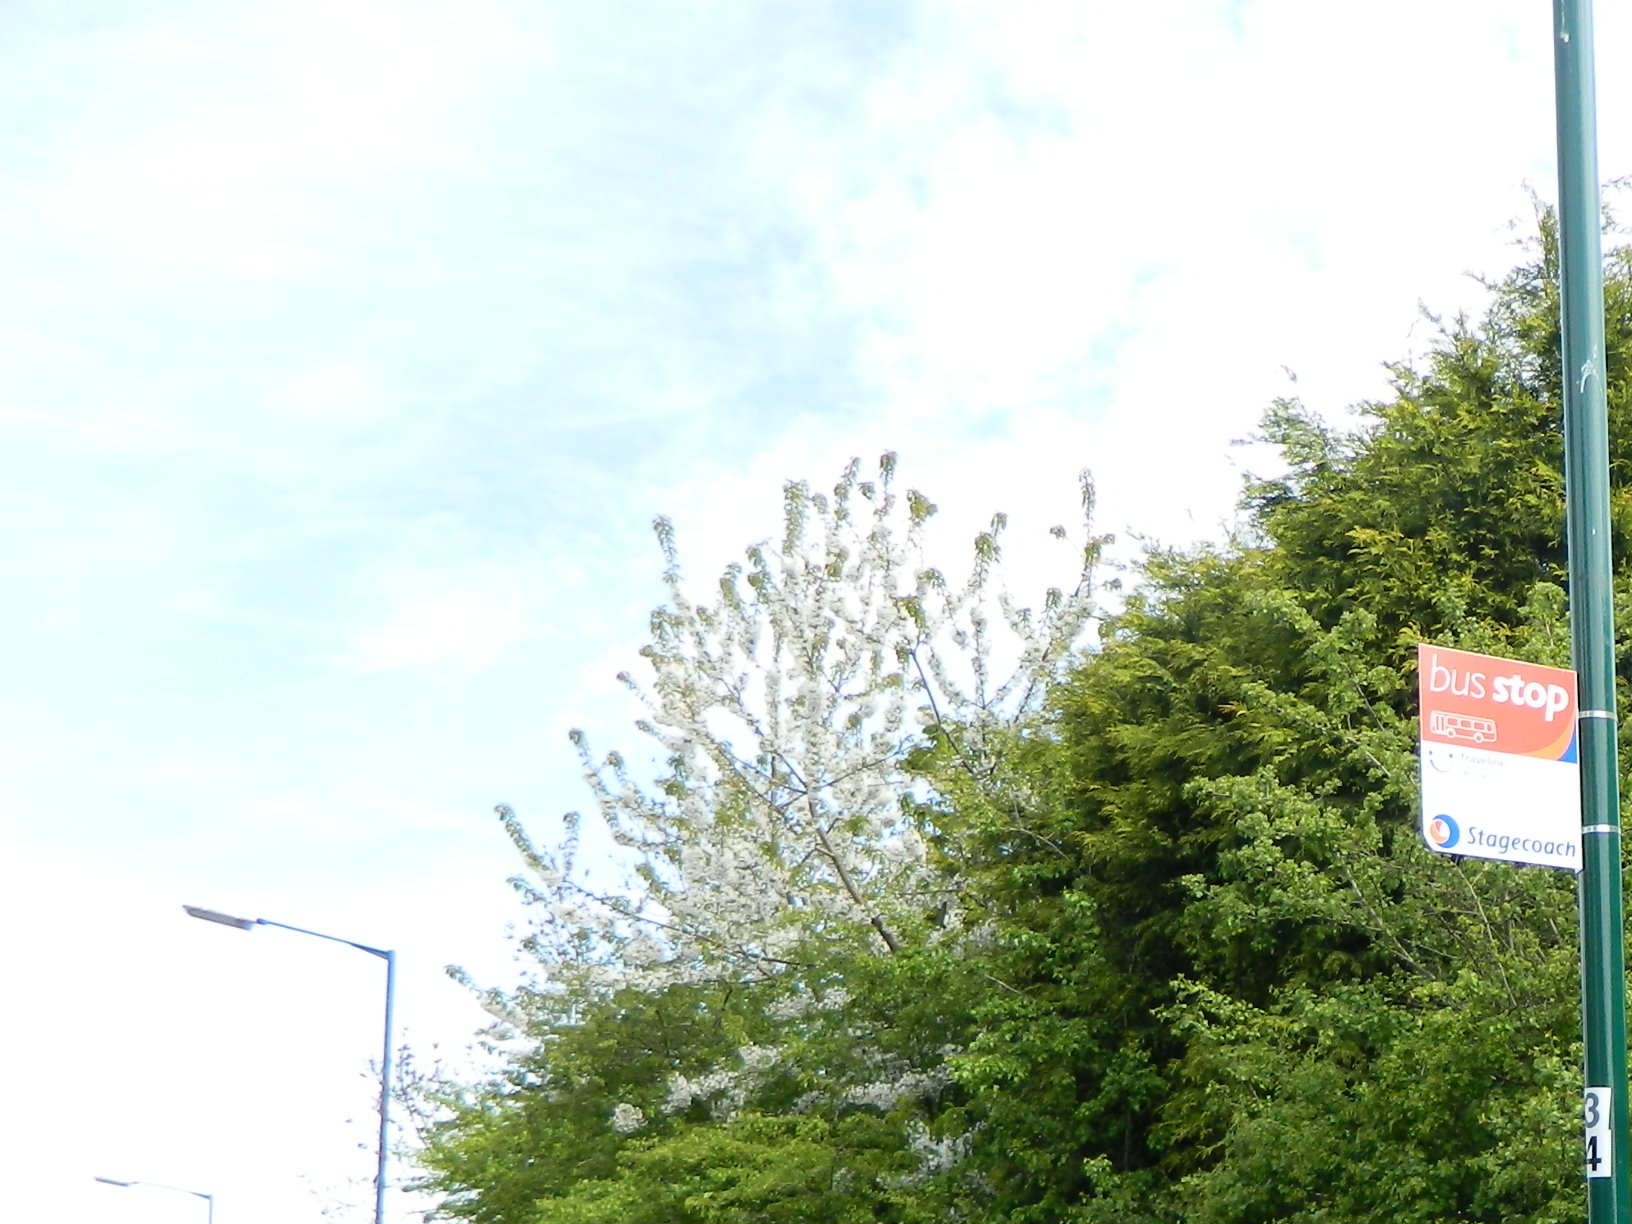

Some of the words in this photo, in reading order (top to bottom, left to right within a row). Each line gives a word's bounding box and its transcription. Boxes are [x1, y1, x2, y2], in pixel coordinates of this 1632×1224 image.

[1429, 653, 1487, 700] bus
[1492, 673, 1570, 722] stop
[1467, 826, 1577, 858] Stagecoach
[1584, 1092, 1600, 1129] 3
[1586, 1135, 1603, 1172] 4
